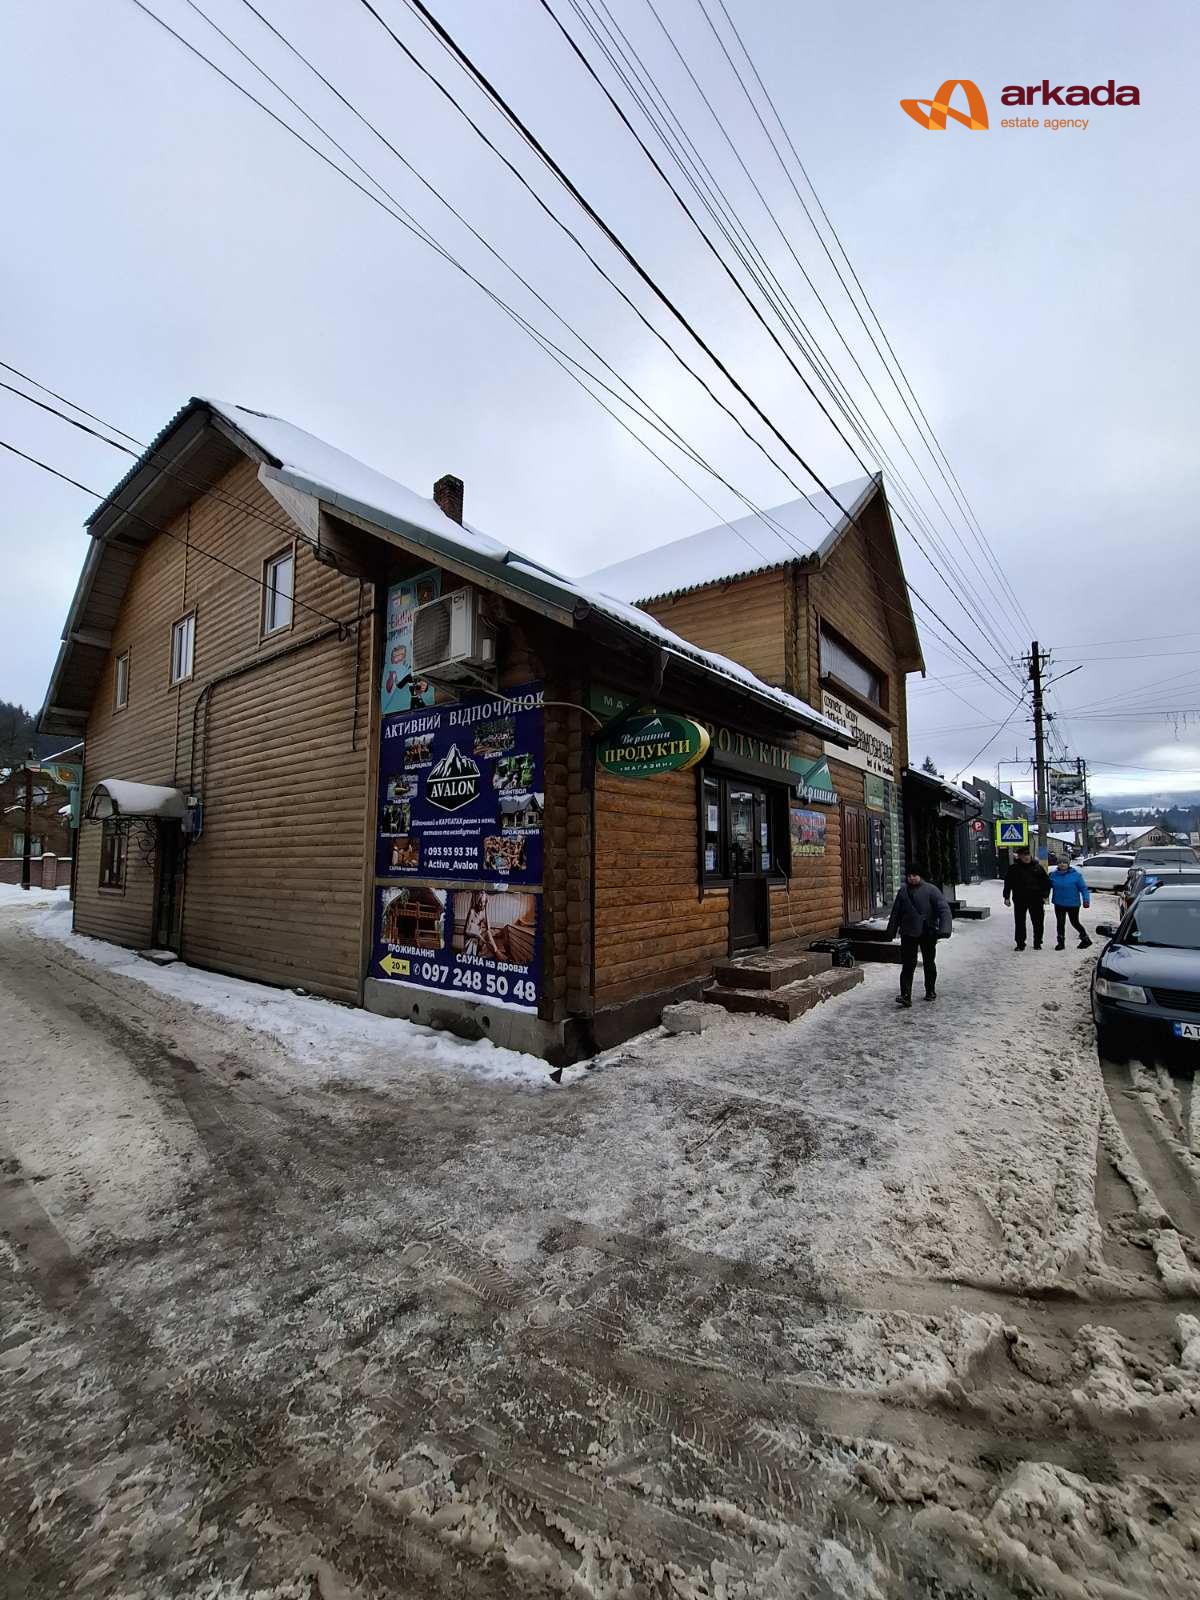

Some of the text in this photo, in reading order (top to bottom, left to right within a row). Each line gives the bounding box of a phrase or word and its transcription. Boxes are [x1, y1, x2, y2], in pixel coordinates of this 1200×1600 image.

[602, 695, 630, 711] МА
[384, 691, 544, 739] АКТИВНИЙ ВІДПОЧИНОК
[604, 739, 690, 763] ПРОДУКТИ
[698, 719, 791, 770] РОДУКТИ
[624, 762, 668, 771] МАГАЗИН
[430, 779, 475, 798] AVALON
[428, 847, 478, 856] 093 93 93 314
[428, 860, 478, 871] Active_Avalon
[388, 943, 435, 959] ПРОЖИВАННЯ
[391, 961, 401, 970] 20
[456, 953, 484, 967] САУНА
[496, 962, 529, 975] дровах
[421, 962, 537, 1002] 097 248 50 48
